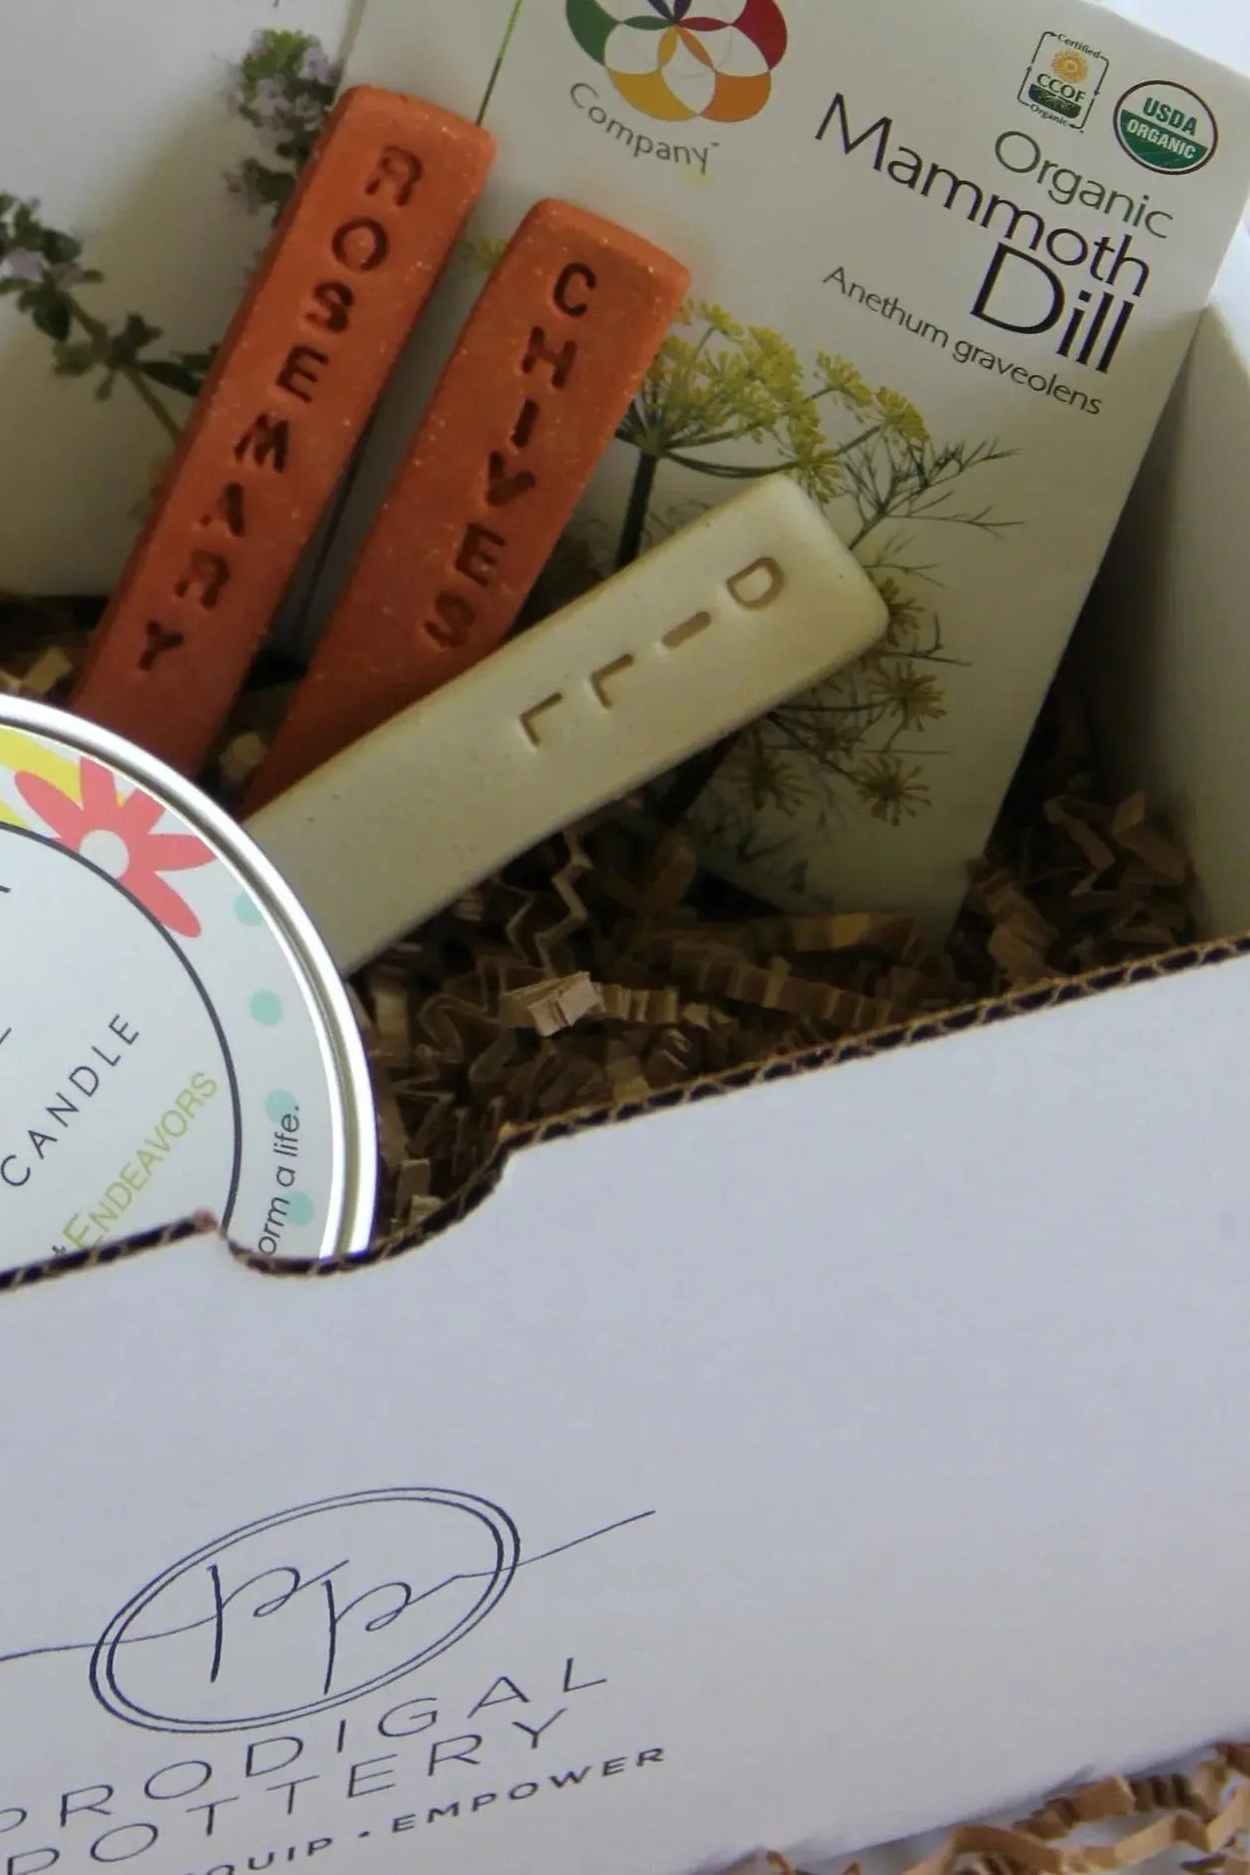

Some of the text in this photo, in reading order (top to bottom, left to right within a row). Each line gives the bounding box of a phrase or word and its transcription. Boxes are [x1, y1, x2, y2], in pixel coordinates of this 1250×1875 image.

[1029, 103, 1071, 127] Organic
[1036, 72, 1087, 103] CCOF
[1056, 32, 1102, 59] Certified
[1142, 96, 1198, 136] USDA
[813, 92, 1151, 297] Mammoth
[993, 129, 1173, 241] Organic
[1126, 118, 1197, 159] ORGANIC
[822, 266, 1104, 416] Anethum graveolens
[969, 241, 1134, 375] Dill
[143, 145, 424, 674] ROSEMARY
[423, 262, 598, 651] CHIVES
[519, 556, 787, 751] DILL
[0, 1013, 143, 1187] CANDLE
[62, 1071, 220, 1250] ENDEAVORS
[257, 1104, 301, 1256] orm a life.
[6, 1708, 568, 1875] POTTERY
[184, 1746, 667, 1875] UIP EMPOWER
